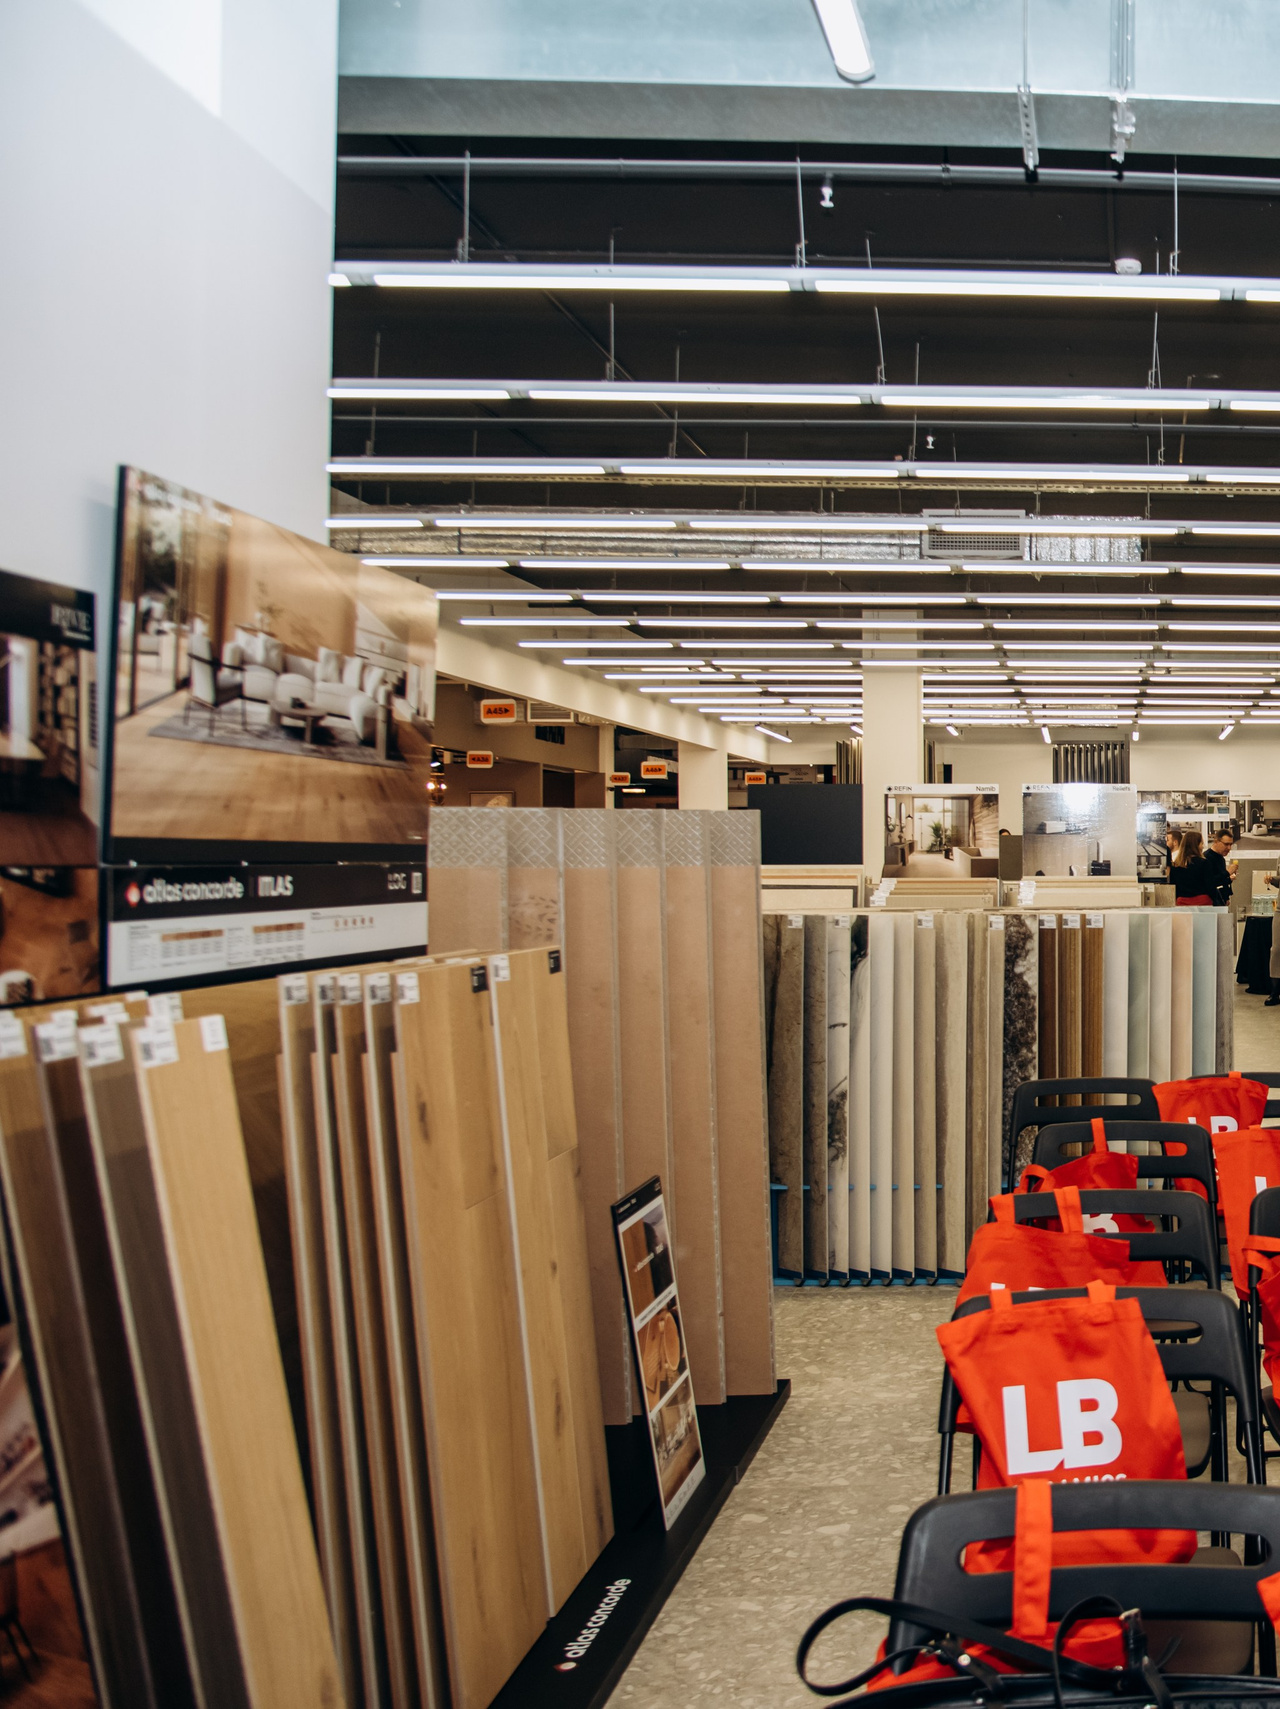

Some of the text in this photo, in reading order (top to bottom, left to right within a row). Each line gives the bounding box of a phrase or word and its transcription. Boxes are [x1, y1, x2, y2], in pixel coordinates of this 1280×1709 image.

[486, 707, 503, 715] A45
[142, 875, 245, 904] atlas concorde
[1002, 1378, 1123, 1475] LB
[563, 1578, 632, 1658] atlas concorde
